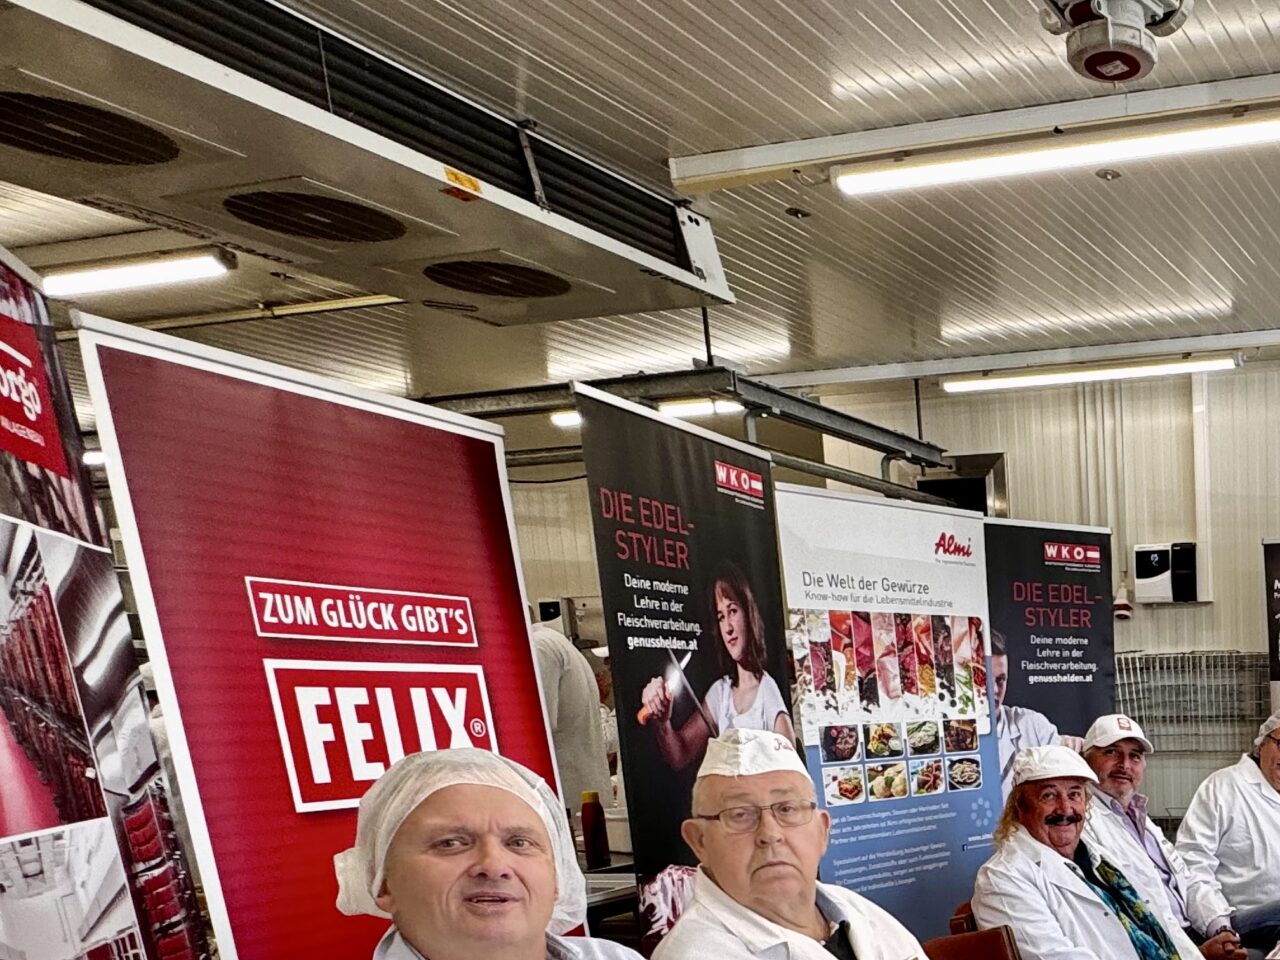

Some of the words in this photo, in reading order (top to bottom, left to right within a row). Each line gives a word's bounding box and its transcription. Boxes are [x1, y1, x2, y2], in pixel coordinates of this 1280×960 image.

[715, 463, 750, 490] WKO
[600, 487, 635, 524] DIE
[639, 496, 695, 536] EDEL-
[615, 530, 690, 570] STYLER
[934, 531, 973, 558] Almi
[1045, 544, 1085, 560] WKO
[624, 573, 651, 589] Deine
[652, 578, 689, 595] moderne
[802, 571, 824, 588] Die
[826, 572, 855, 590] Welt
[858, 575, 878, 591] der
[881, 576, 930, 595] Gewürze
[1013, 582, 1044, 602] DIE
[1048, 583, 1103, 605] EDEL-
[633, 594, 660, 610] Lehre
[661, 598, 669, 611] in
[670, 599, 684, 612] der
[804, 590, 848, 602] Know-how
[862, 593, 874, 604] die
[258, 592, 319, 626] ZUM
[321, 594, 398, 631] GLÜCK
[401, 604, 468, 635] GIBT'S
[1024, 607, 1092, 628] STYLER
[627, 635, 698, 651] genusshelden.at
[1030, 634, 1053, 645] Deine
[1055, 636, 1089, 645] moderne
[1037, 648, 1061, 658] Lehre
[1062, 648, 1070, 658] in
[1071, 649, 1084, 658] der
[1028, 673, 1093, 685] genusshelden.at
